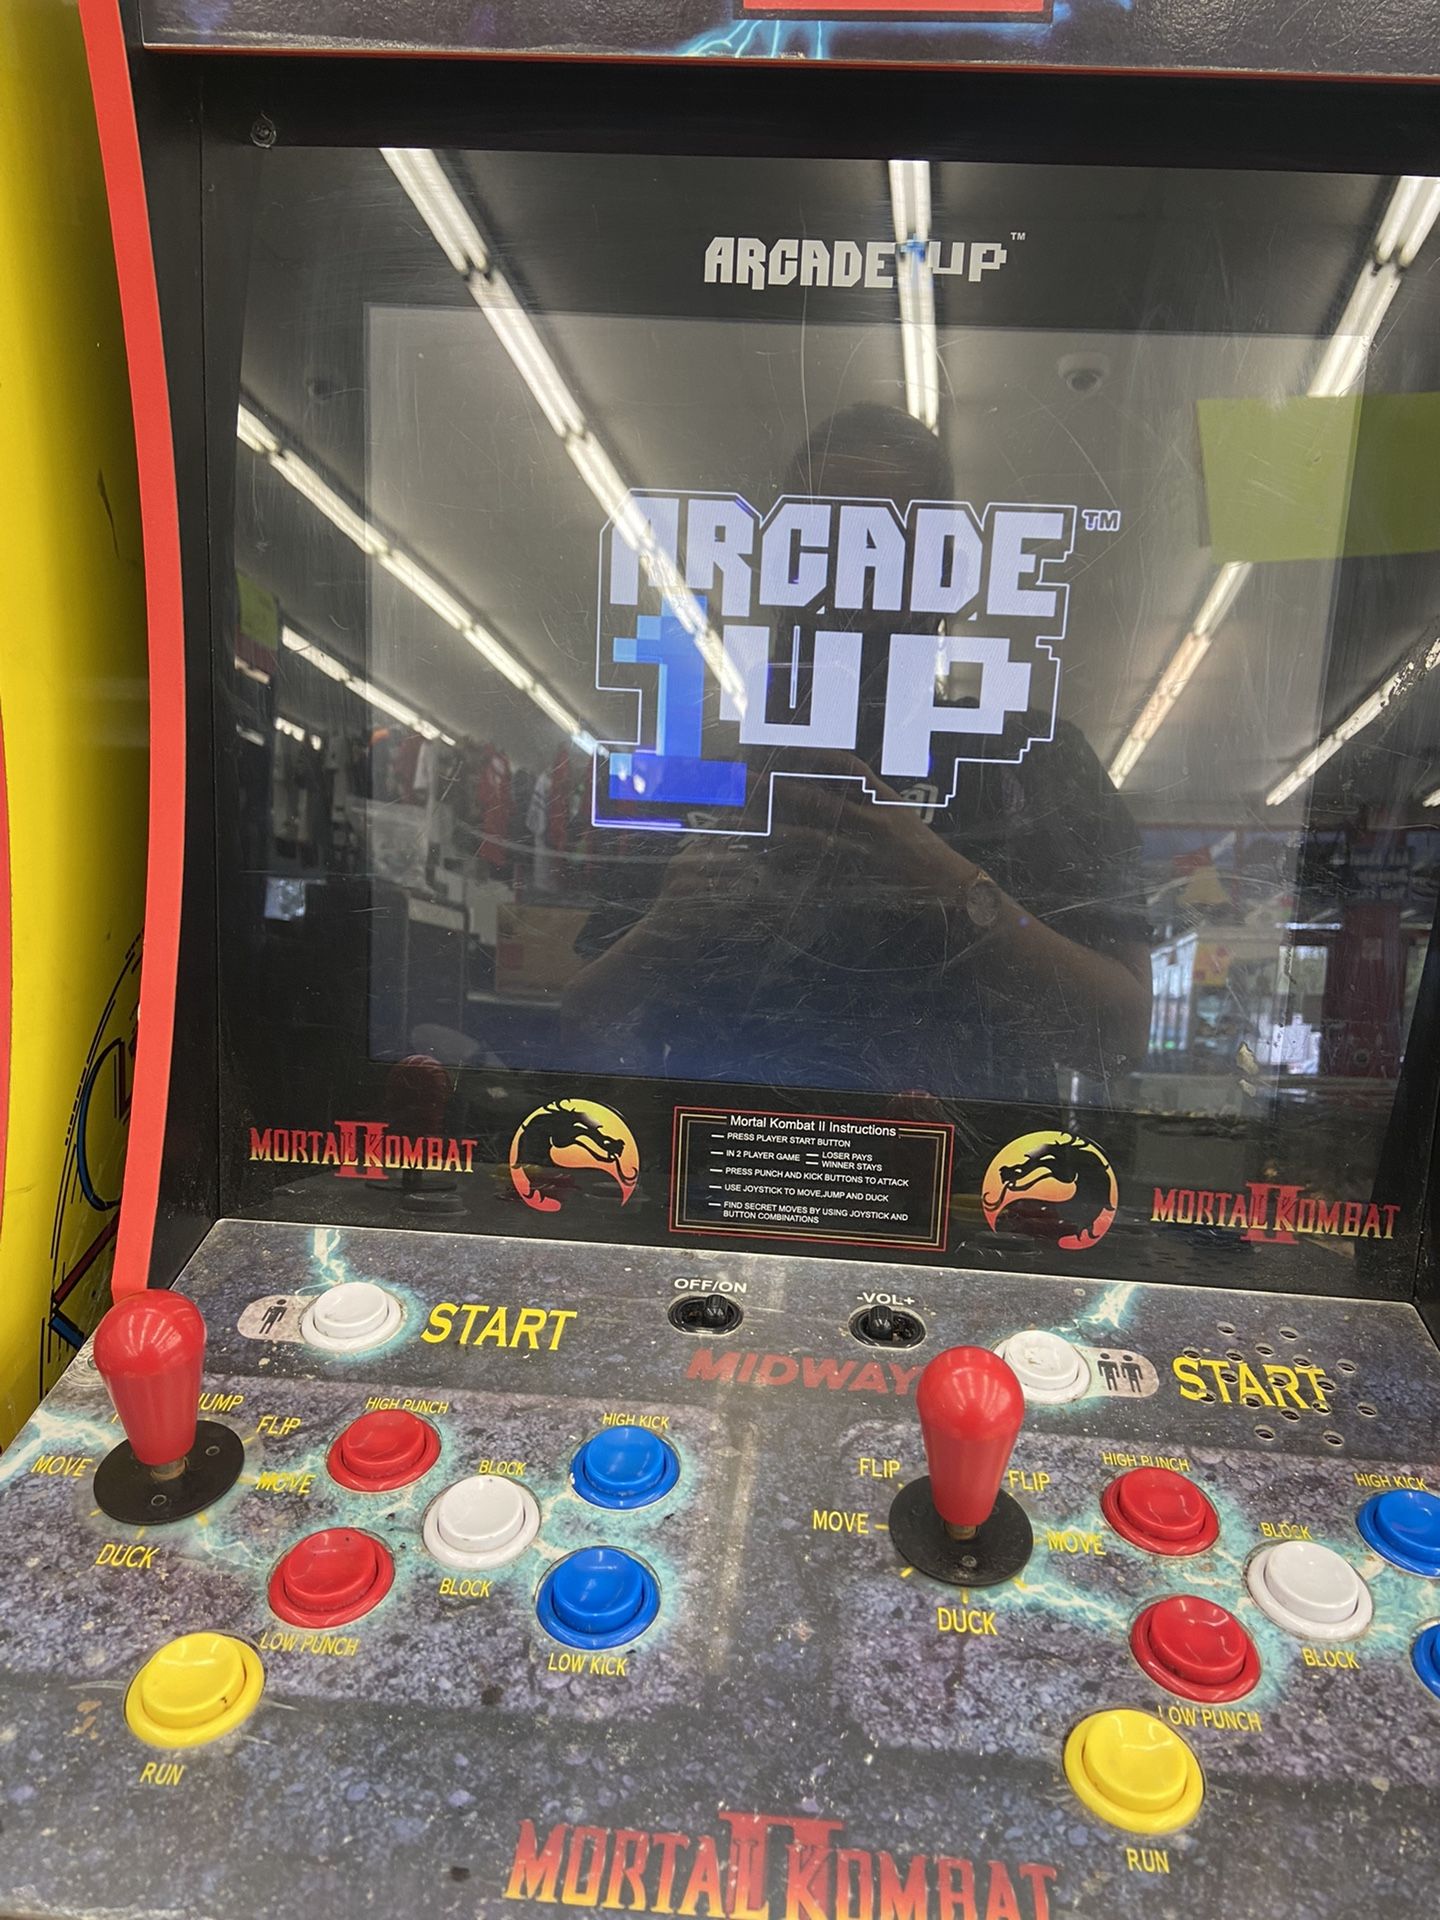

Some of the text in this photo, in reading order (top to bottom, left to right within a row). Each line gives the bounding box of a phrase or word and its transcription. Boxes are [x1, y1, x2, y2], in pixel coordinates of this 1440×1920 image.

[704, 237, 896, 290] ARCADE
[609, 497, 1064, 617] ARCADE
[730, 1115, 767, 1128] Mortal
[769, 1117, 816, 1131] Kombat
[829, 1121, 897, 1137] Instructions
[249, 1126, 478, 1173] MORTAL KOMBAT
[727, 1132, 851, 1148] PRESS PLAYER START BUTTON
[726, 1149, 801, 1162] IN 2 PLAYER GAME
[821, 1160, 883, 1172] WINNER STAYS
[822, 1151, 873, 1162] LOSER PAYS
[725, 1167, 909, 1187] PRESS PUNCH AND KICK BUTTONS TO ATTACK
[724, 1183, 742, 1192] USE
[742, 1184, 783, 1195] JOYSTICK
[784, 1187, 795, 1195] TO
[846, 1192, 864, 1201] AND
[865, 1193, 889, 1202] DUCK
[723, 1201, 909, 1222] FIND SECRET MOVES BY USING JOYSTICK AND
[723, 1210, 820, 1224] BUTTON COMBINATIONS
[1150, 1187, 1401, 1240] MORTAL KOMBAT
[674, 1278, 748, 1294] OFF/ON
[421, 1301, 578, 1351] START
[685, 1347, 927, 1396] MIDWAY
[1172, 1356, 1328, 1411] START
[365, 1396, 450, 1415] HIGH PUNCH
[256, 1416, 302, 1435] FLIP
[602, 1412, 670, 1430] HIGH KICK
[31, 1455, 93, 1477] MOVE
[478, 1459, 526, 1476] BLOCK
[859, 1458, 901, 1479] FLIP
[1102, 1452, 1191, 1472] HIGH PUNCH
[256, 1471, 317, 1495] MOVE
[1008, 1470, 1051, 1492] FLIP
[1354, 1472, 1429, 1491] HIGH KICK
[812, 1510, 869, 1535] MOVE
[1260, 1521, 1313, 1540] BLOCK
[1046, 1531, 1107, 1556] MOVE
[95, 1543, 160, 1569] DUCK
[438, 1577, 493, 1598] BLOCK
[937, 1607, 998, 1635] DUCK
[259, 1632, 361, 1657] LOW PUNCH
[548, 1653, 629, 1677] LOW KICK
[1302, 1648, 1361, 1670] BLOCK
[1201, 1708, 1263, 1733] PUNCH
[140, 1761, 186, 1786] RUN
[502, 1818, 1058, 1920] MORTAL KOMBAT
[1126, 1847, 1171, 1874] RUN
